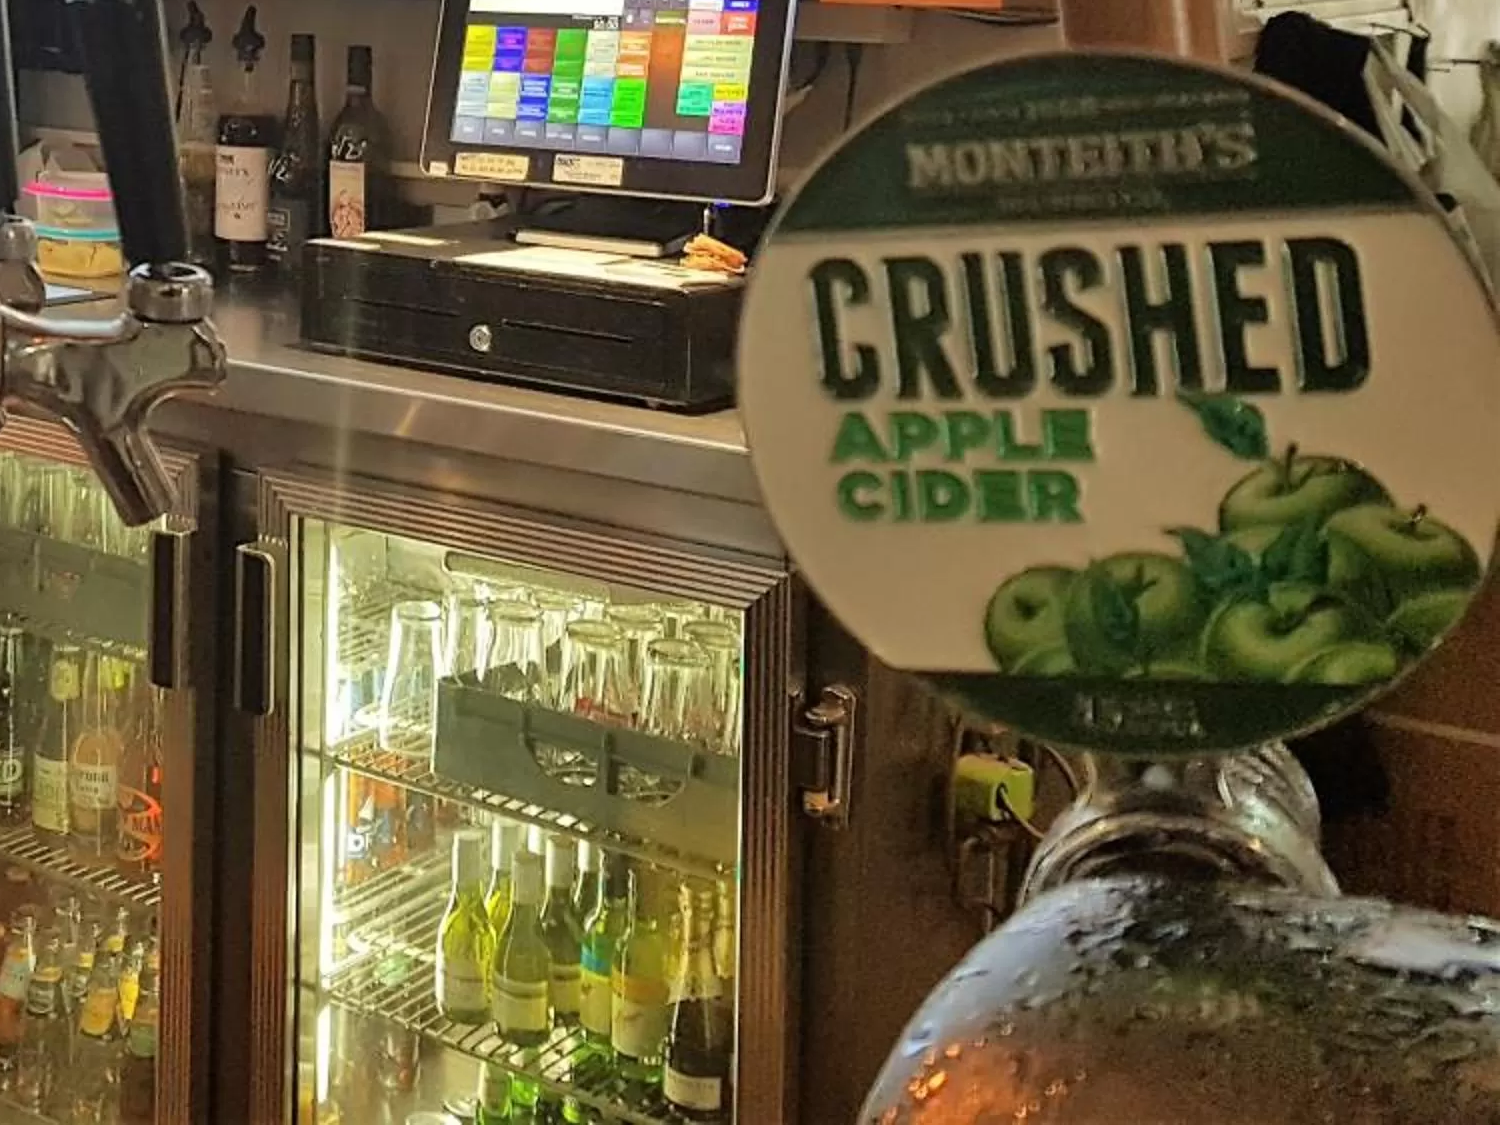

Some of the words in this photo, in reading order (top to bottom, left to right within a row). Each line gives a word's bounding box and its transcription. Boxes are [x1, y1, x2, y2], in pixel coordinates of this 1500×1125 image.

[905, 121, 1259, 188] MONTEITH'S
[807, 234, 1374, 406] CRUSHED
[829, 406, 1096, 467] APPLE
[835, 465, 1087, 525] CIDER
